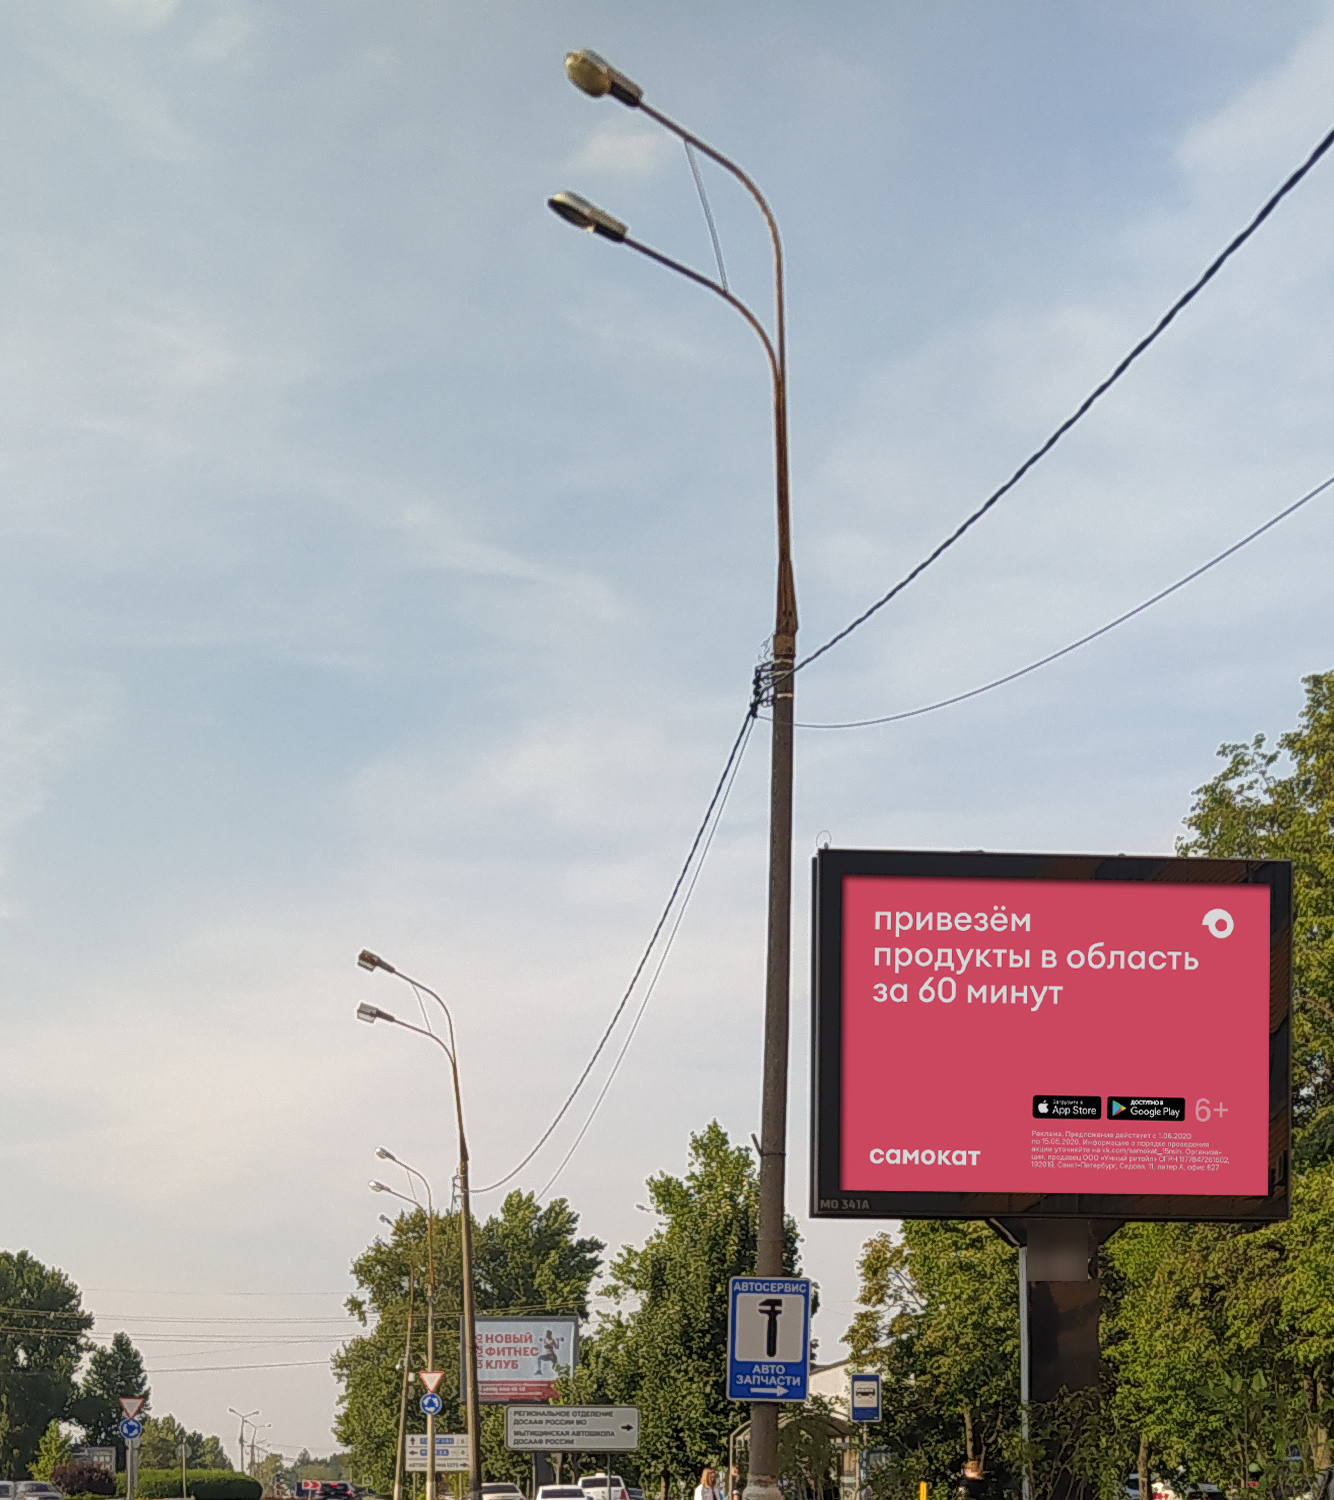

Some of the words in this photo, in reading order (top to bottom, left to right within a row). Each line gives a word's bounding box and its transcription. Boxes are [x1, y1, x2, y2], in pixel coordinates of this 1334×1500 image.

[874, 905, 1032, 938] привезём
[873, 947, 1032, 975] продукты
[1041, 949, 1058, 969] в
[1066, 942, 1200, 971] область
[872, 982, 908, 1003] за
[918, 976, 957, 1004] 60
[967, 984, 1064, 1012] минут
[1052, 1105, 1071, 1116] App
[1072, 1105, 1097, 1116] Store
[1130, 1106, 1161, 1118] Google
[1162, 1107, 1181, 1119] Play
[1195, 1097, 1229, 1122] 6+
[869, 1148, 981, 1166] самокат
[733, 1281, 807, 1293] АВТОСЕРВИС
[485, 1331, 533, 1344] НОВЫЙ
[485, 1346, 540, 1357] ФИТНЕС
[485, 1359, 519, 1370] КЛУБ
[752, 1364, 786, 1375] АВТО
[735, 1374, 801, 1387] ЗАПЧАСТИ
